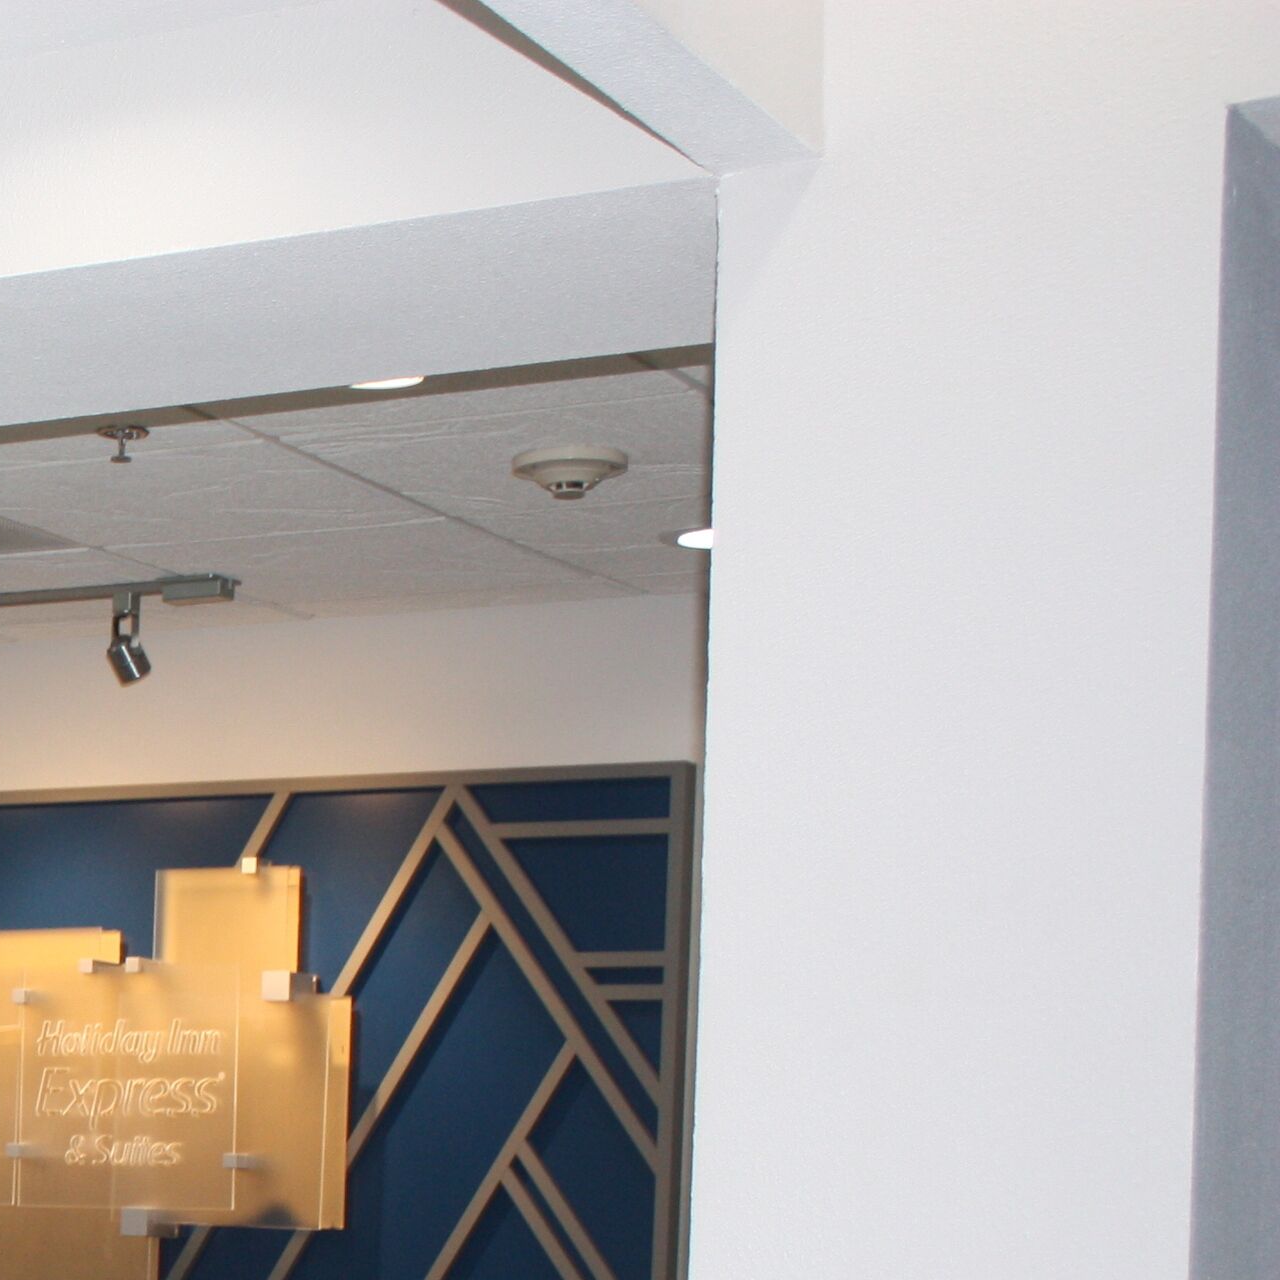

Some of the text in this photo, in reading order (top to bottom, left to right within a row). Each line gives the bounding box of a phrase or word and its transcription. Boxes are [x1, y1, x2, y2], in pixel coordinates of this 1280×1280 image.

[36, 1017, 224, 1063] Holiday Inn
[35, 1066, 218, 1130] Express
[64, 1135, 183, 1167] & Suites
